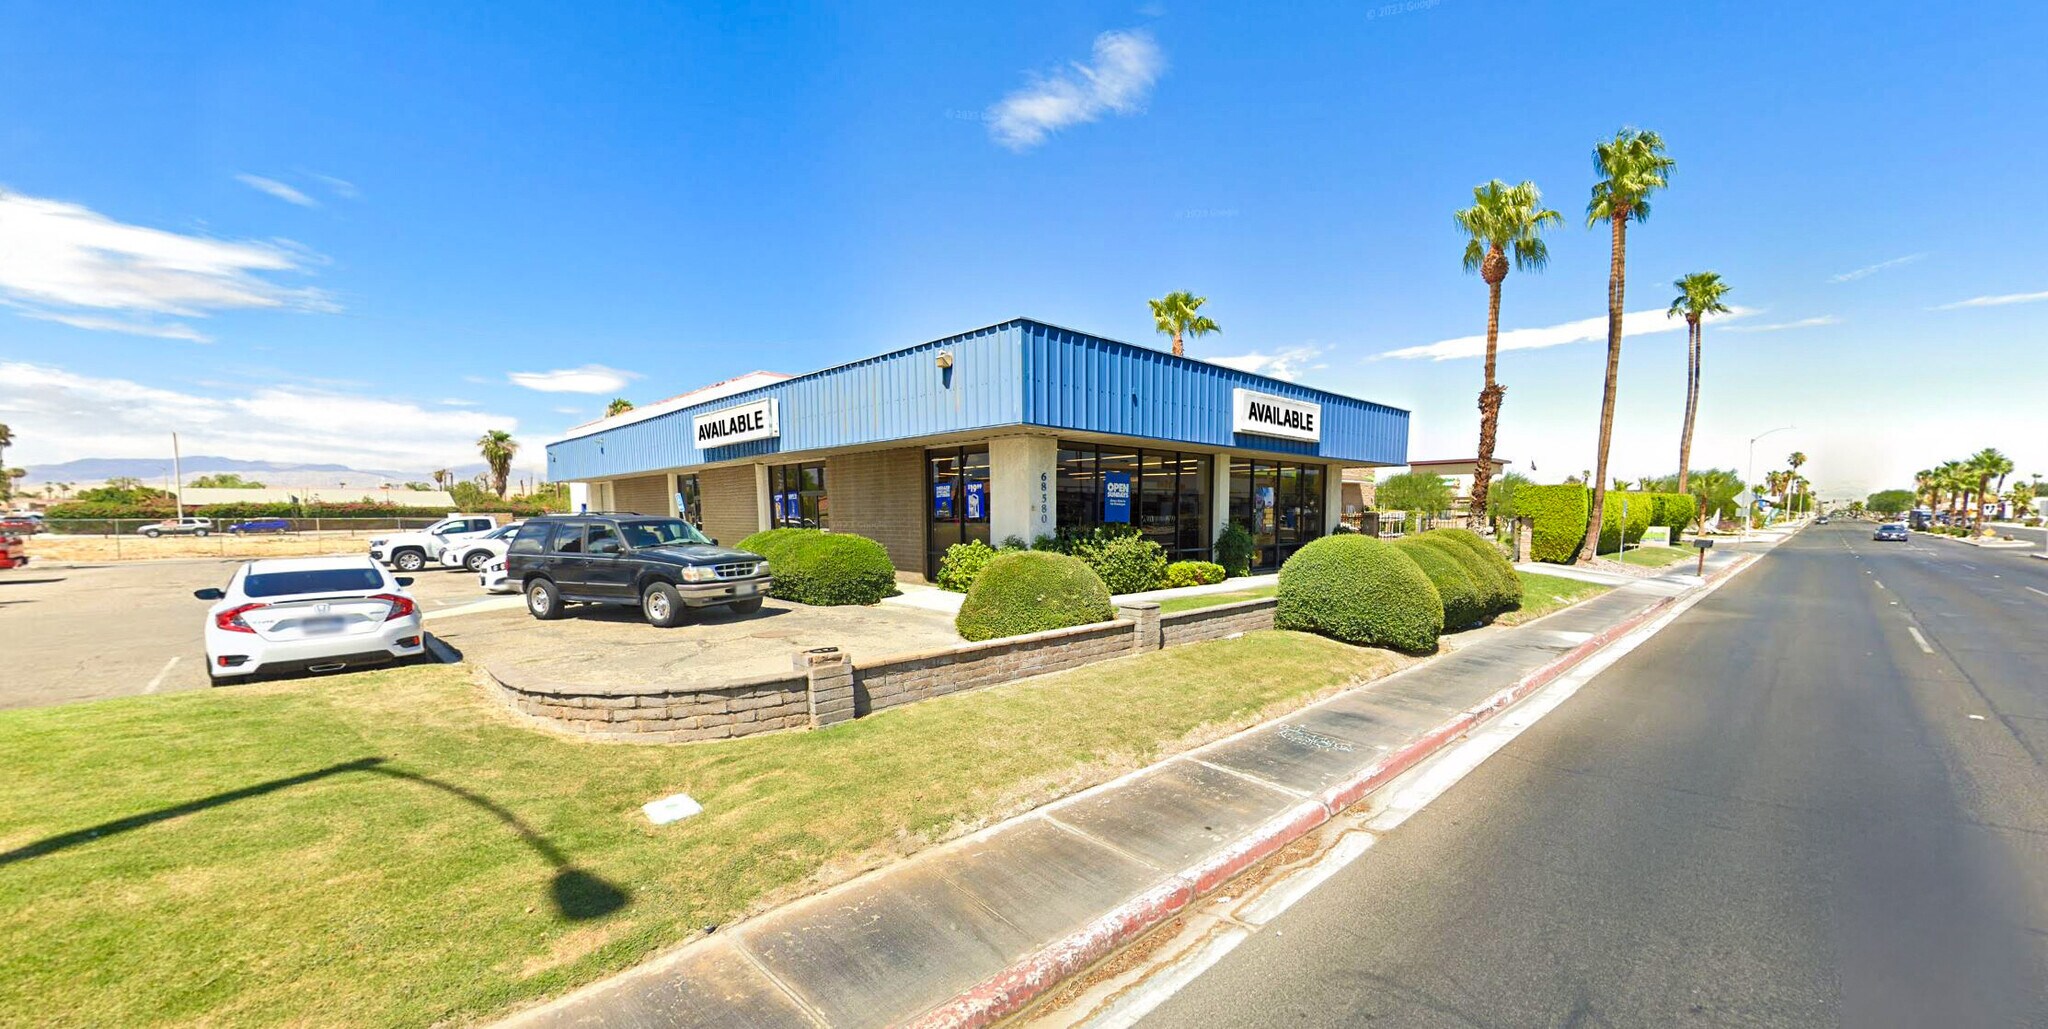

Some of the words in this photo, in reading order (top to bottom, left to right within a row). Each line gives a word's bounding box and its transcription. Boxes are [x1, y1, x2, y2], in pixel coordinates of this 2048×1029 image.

[698, 410, 764, 442] AVAILABLE
[1248, 401, 1314, 432] AVAILABLE
[1107, 482, 1129, 492] OPEN
